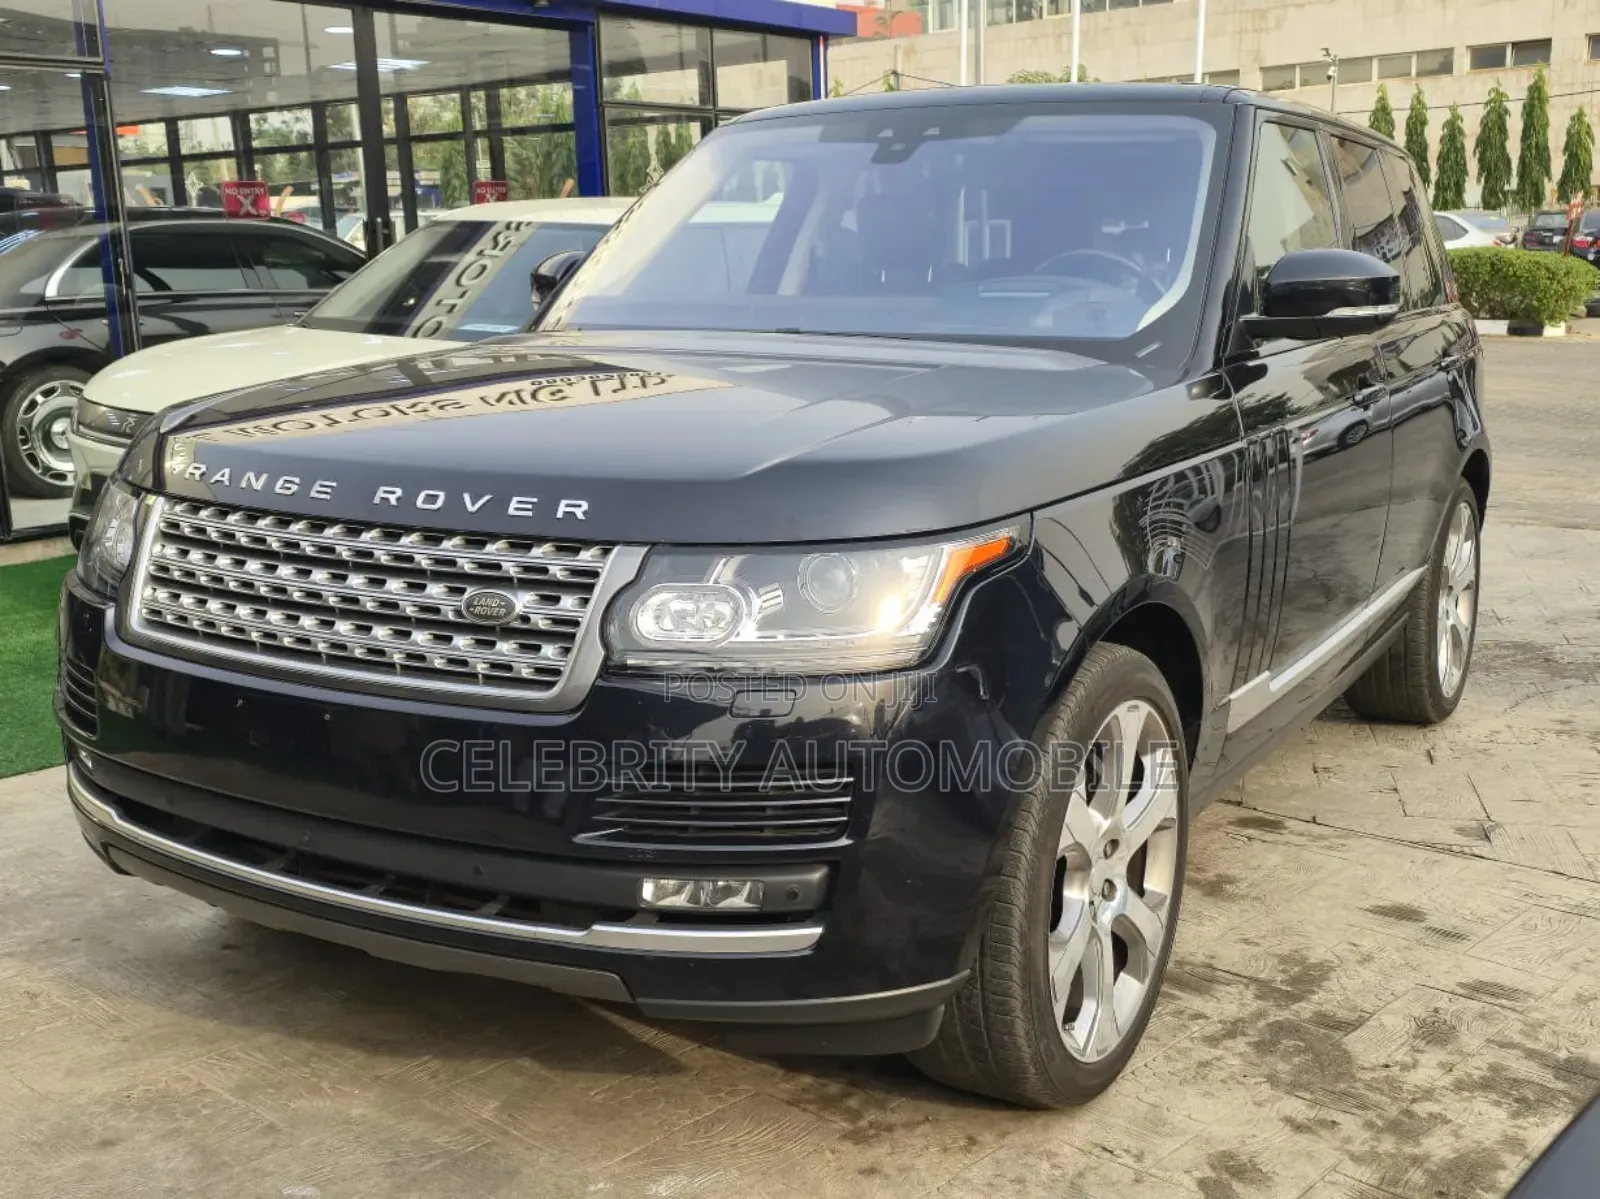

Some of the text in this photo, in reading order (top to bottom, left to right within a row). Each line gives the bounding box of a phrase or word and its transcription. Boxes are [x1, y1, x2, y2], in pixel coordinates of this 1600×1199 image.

[224, 186, 265, 196] NO ENTRY
[184, 462, 589, 520] RANGE ROVER
